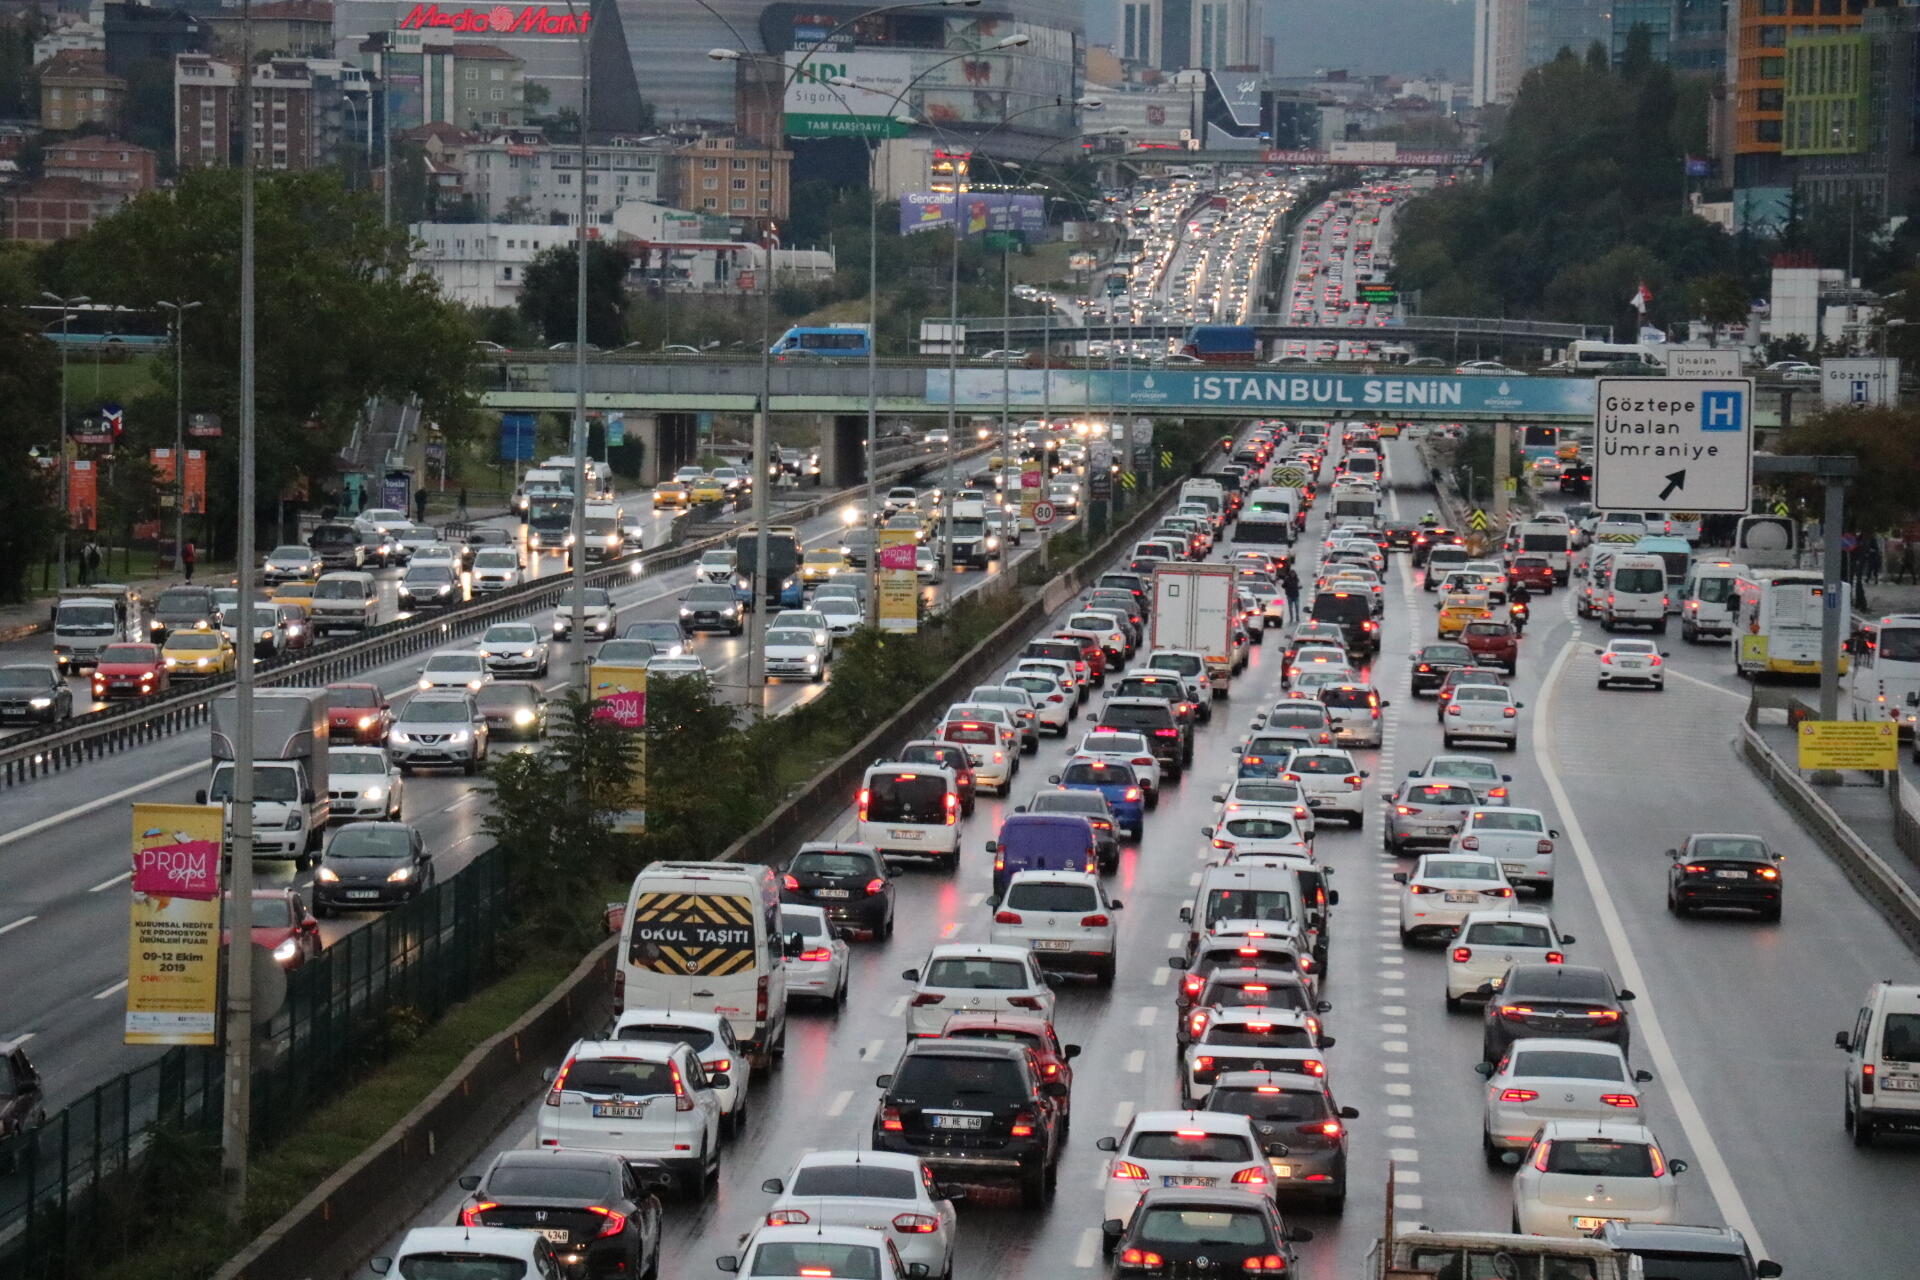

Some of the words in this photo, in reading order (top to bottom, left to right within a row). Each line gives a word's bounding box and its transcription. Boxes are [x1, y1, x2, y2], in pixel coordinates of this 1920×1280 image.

[401, 4, 490, 32] Media
[510, 6, 592, 34] Markt
[796, 62, 846, 84] HDI
[808, 121, 829, 131] TAM
[1677, 357, 1717, 365] Ünalan
[1606, 397, 1696, 416] Göztepe
[1605, 416, 1680, 434] Ünalan
[1604, 438, 1719, 460] Ümraniye
[1037, 506, 1051, 519] 80
[884, 549, 912, 560] PROM
[142, 852, 206, 870] PROM
[168, 867, 207, 889] expo
[153, 930, 207, 938] PROMOSYON
[640, 928, 688, 941] OKUL
[696, 928, 749, 945] TAŞITI
[183, 937, 208, 946] FUARI
[142, 952, 173, 961] 09-12
[175, 952, 203, 962] Ekim
[159, 963, 186, 972] 2019
[547, 1230, 568, 1241] 4348
